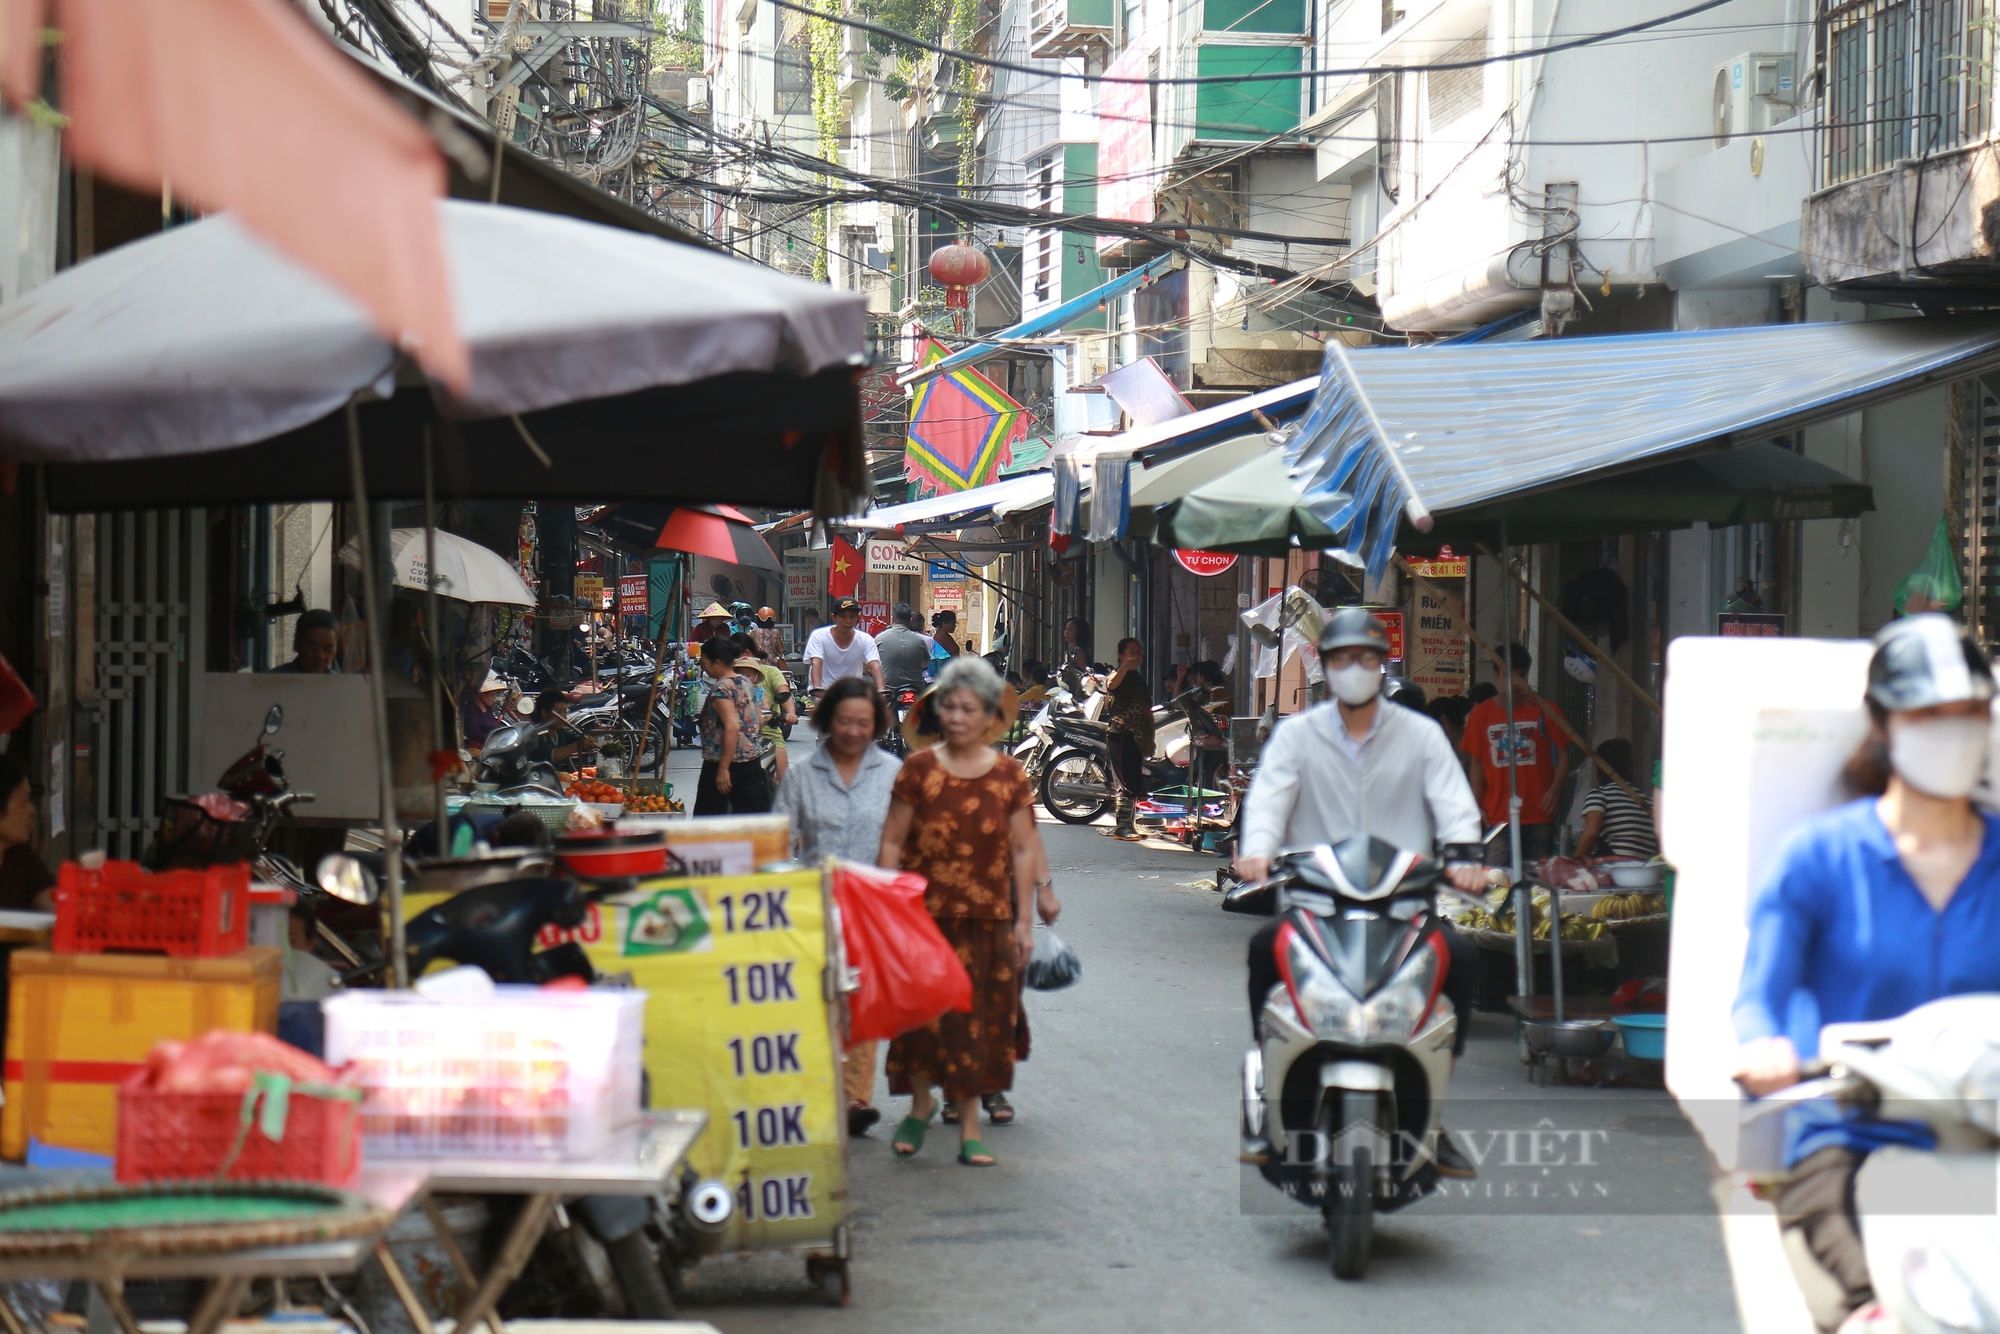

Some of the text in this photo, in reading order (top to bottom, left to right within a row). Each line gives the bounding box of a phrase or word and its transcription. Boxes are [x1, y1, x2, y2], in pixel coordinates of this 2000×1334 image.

[871, 544, 907, 561] CƠM
[898, 563, 919, 571] DÂN
[1186, 556, 1230, 566] TỰ CHỌN
[862, 603, 887, 617] ƠM
[1421, 613, 1451, 630] MIẾN
[719, 890, 790, 932] 12K
[724, 962, 795, 1004] 10K
[729, 1034, 800, 1077] 10K
[734, 1105, 806, 1148] 10K
[739, 1177, 811, 1220] 10K
